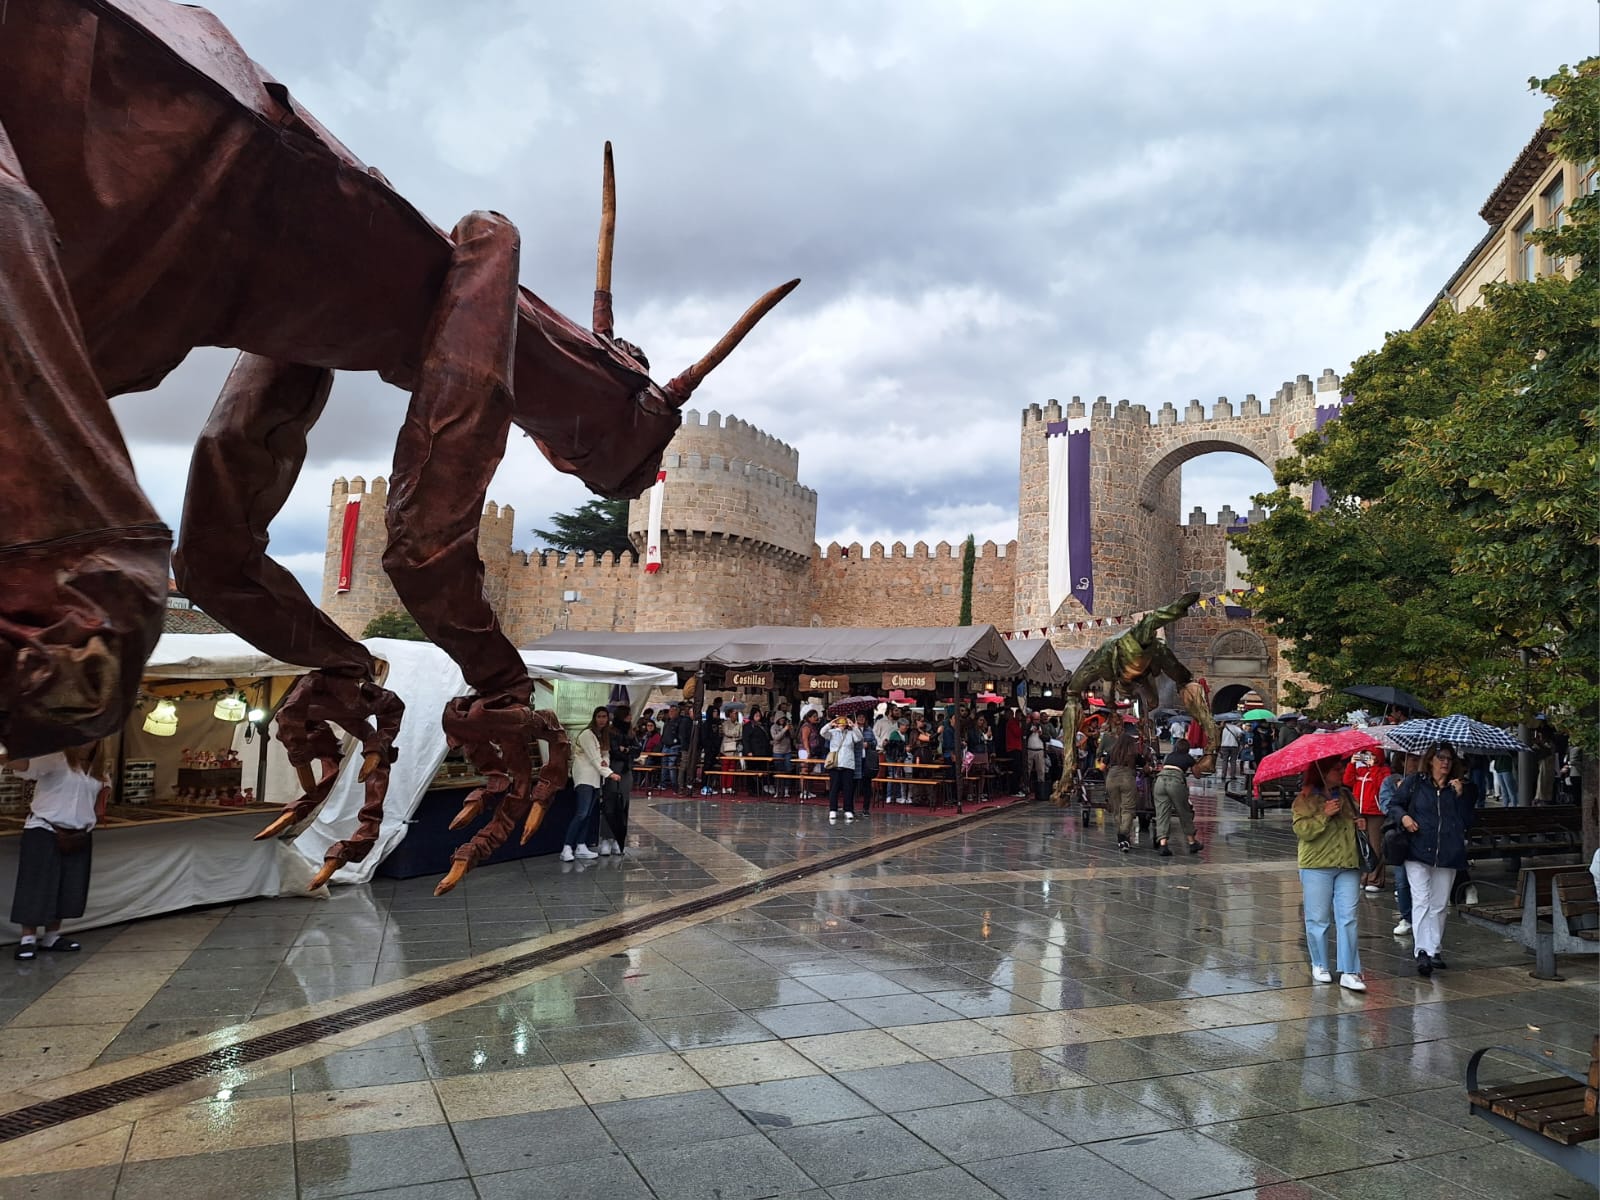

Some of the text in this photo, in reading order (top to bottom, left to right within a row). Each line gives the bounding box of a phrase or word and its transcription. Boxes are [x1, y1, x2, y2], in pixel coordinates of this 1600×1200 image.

[733, 673, 766, 686] Costillas
[809, 677, 839, 689] Secreto
[891, 674, 926, 687] Chorizos
